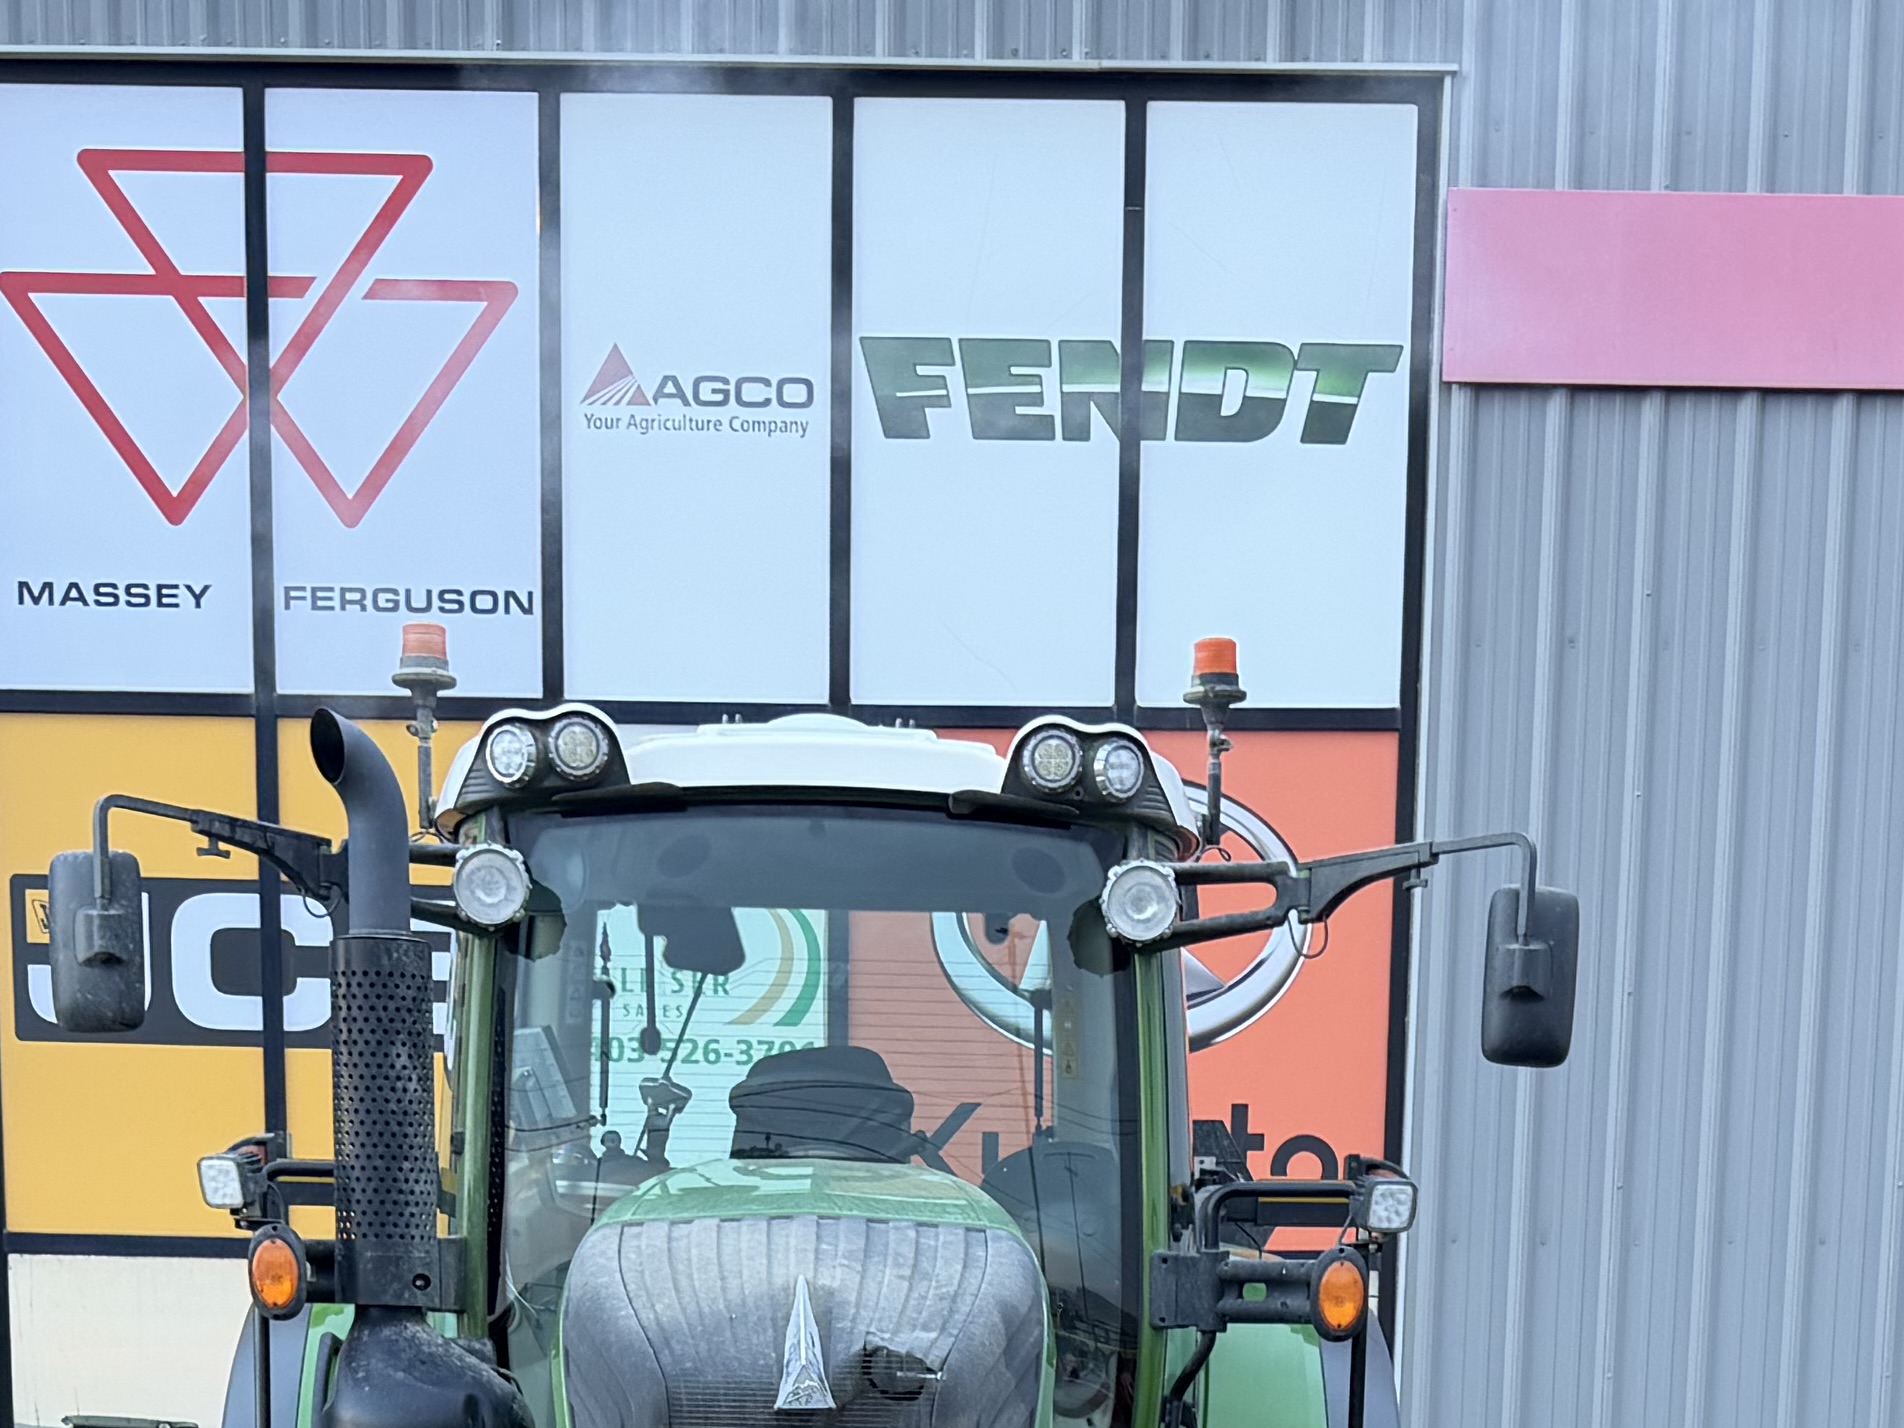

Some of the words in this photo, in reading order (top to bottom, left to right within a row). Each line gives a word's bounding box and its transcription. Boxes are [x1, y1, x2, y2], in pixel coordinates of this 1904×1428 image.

[652, 375, 814, 409] AGCO
[859, 336, 1404, 445] FENDT
[584, 413, 621, 430] Your
[626, 414, 722, 434] Agriculture
[729, 416, 809, 438] Company
[17, 581, 212, 609] MASSEY
[283, 586, 534, 615] FERGUSON
[623, 1004, 684, 1019] SAES
